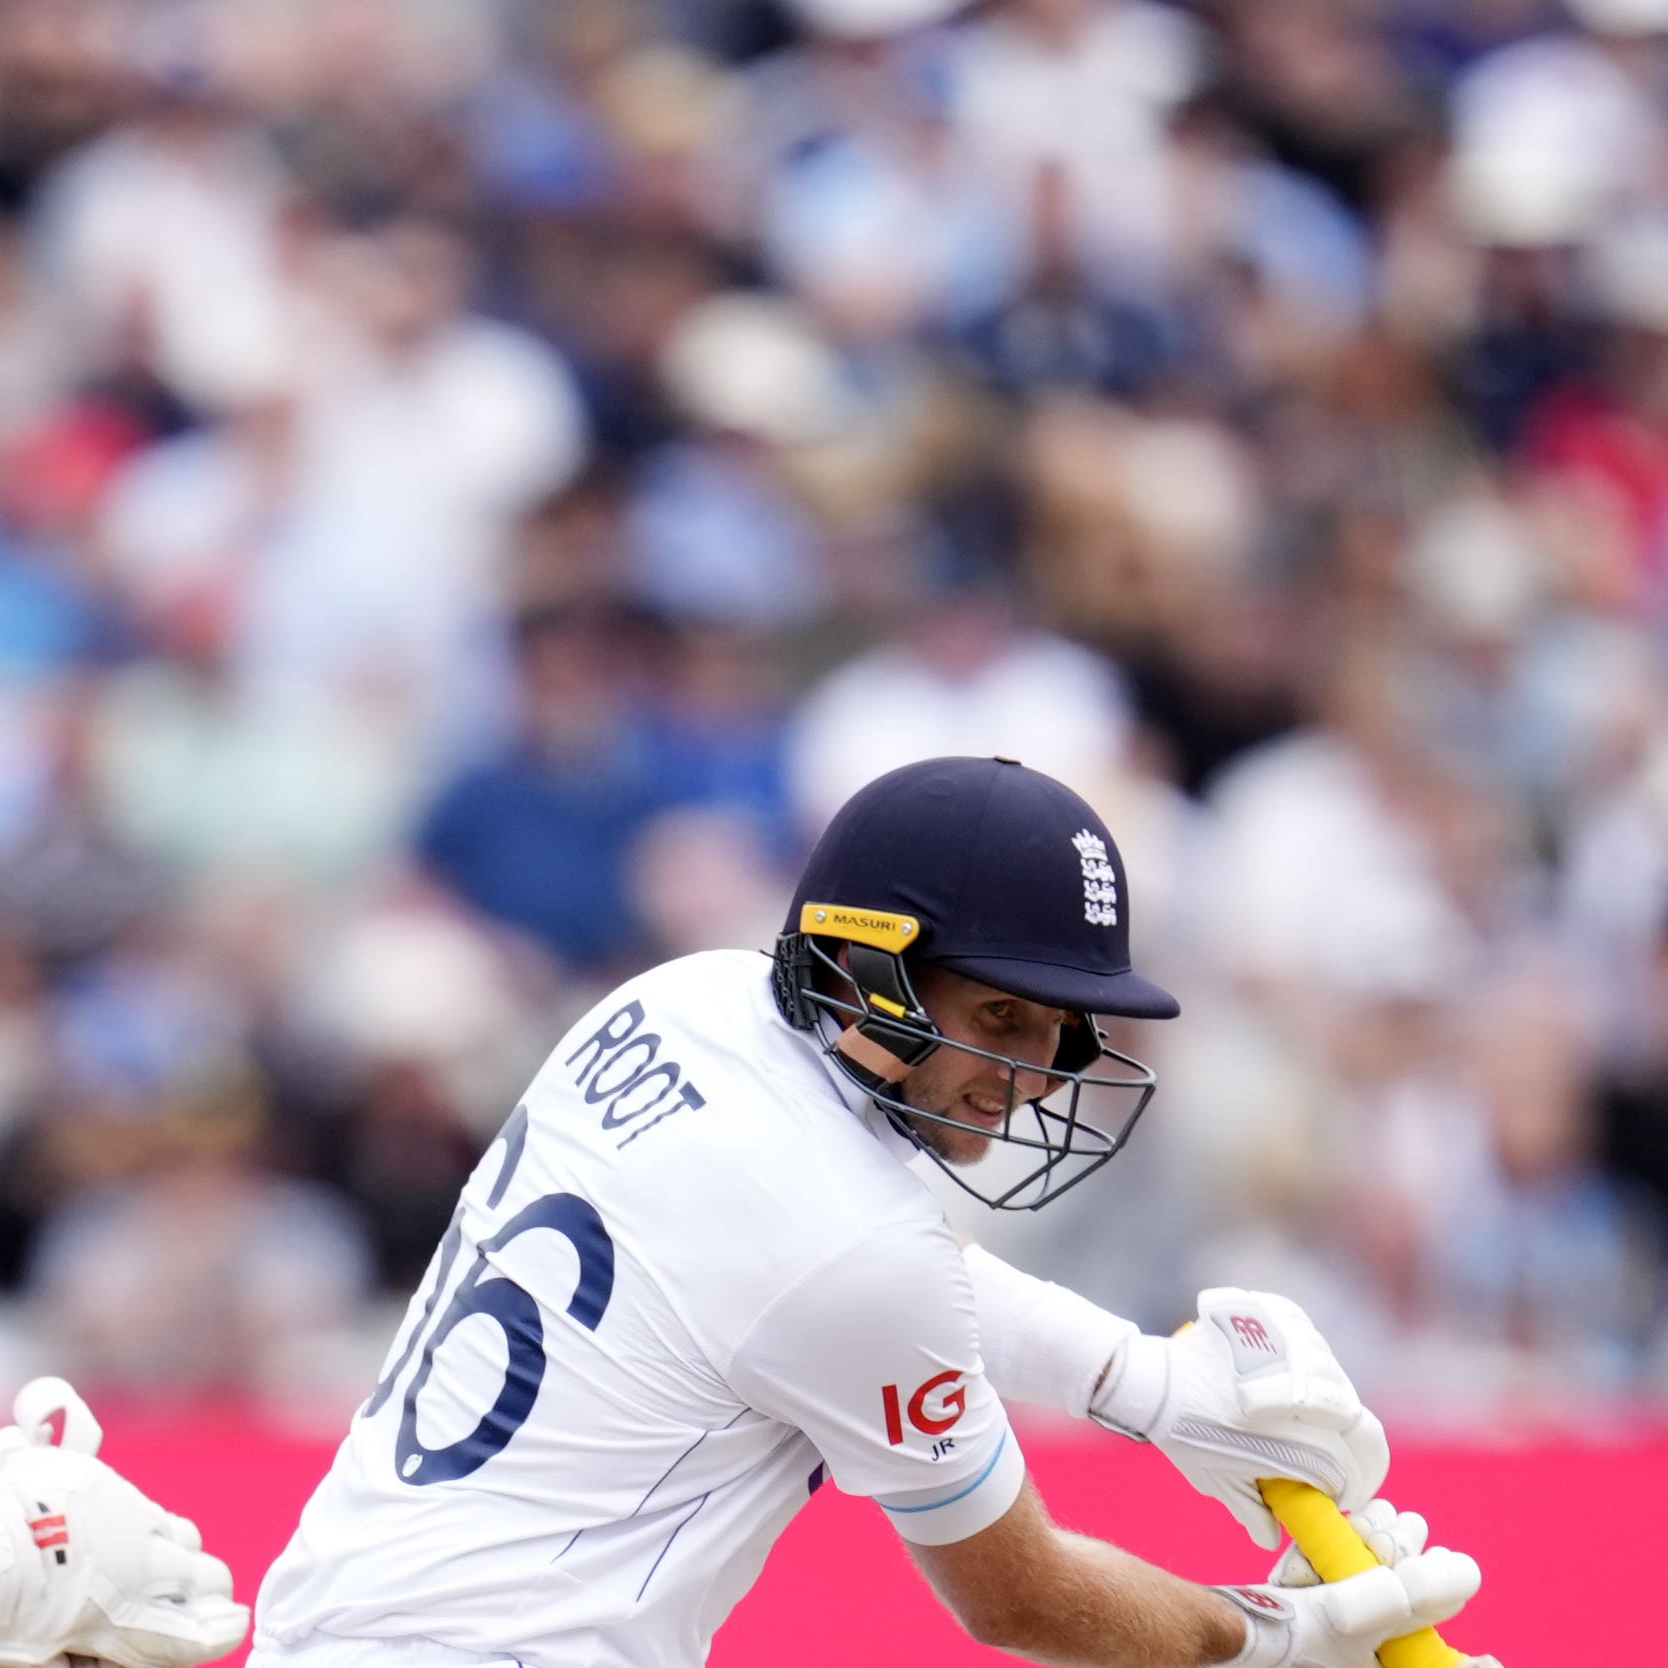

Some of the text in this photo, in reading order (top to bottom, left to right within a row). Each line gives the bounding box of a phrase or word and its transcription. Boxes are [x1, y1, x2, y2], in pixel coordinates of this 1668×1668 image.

[833, 913, 897, 932] MASURI
[564, 998, 708, 1151] ROOT
[881, 1369, 966, 1446] IG
[931, 1437, 955, 1462] JR
